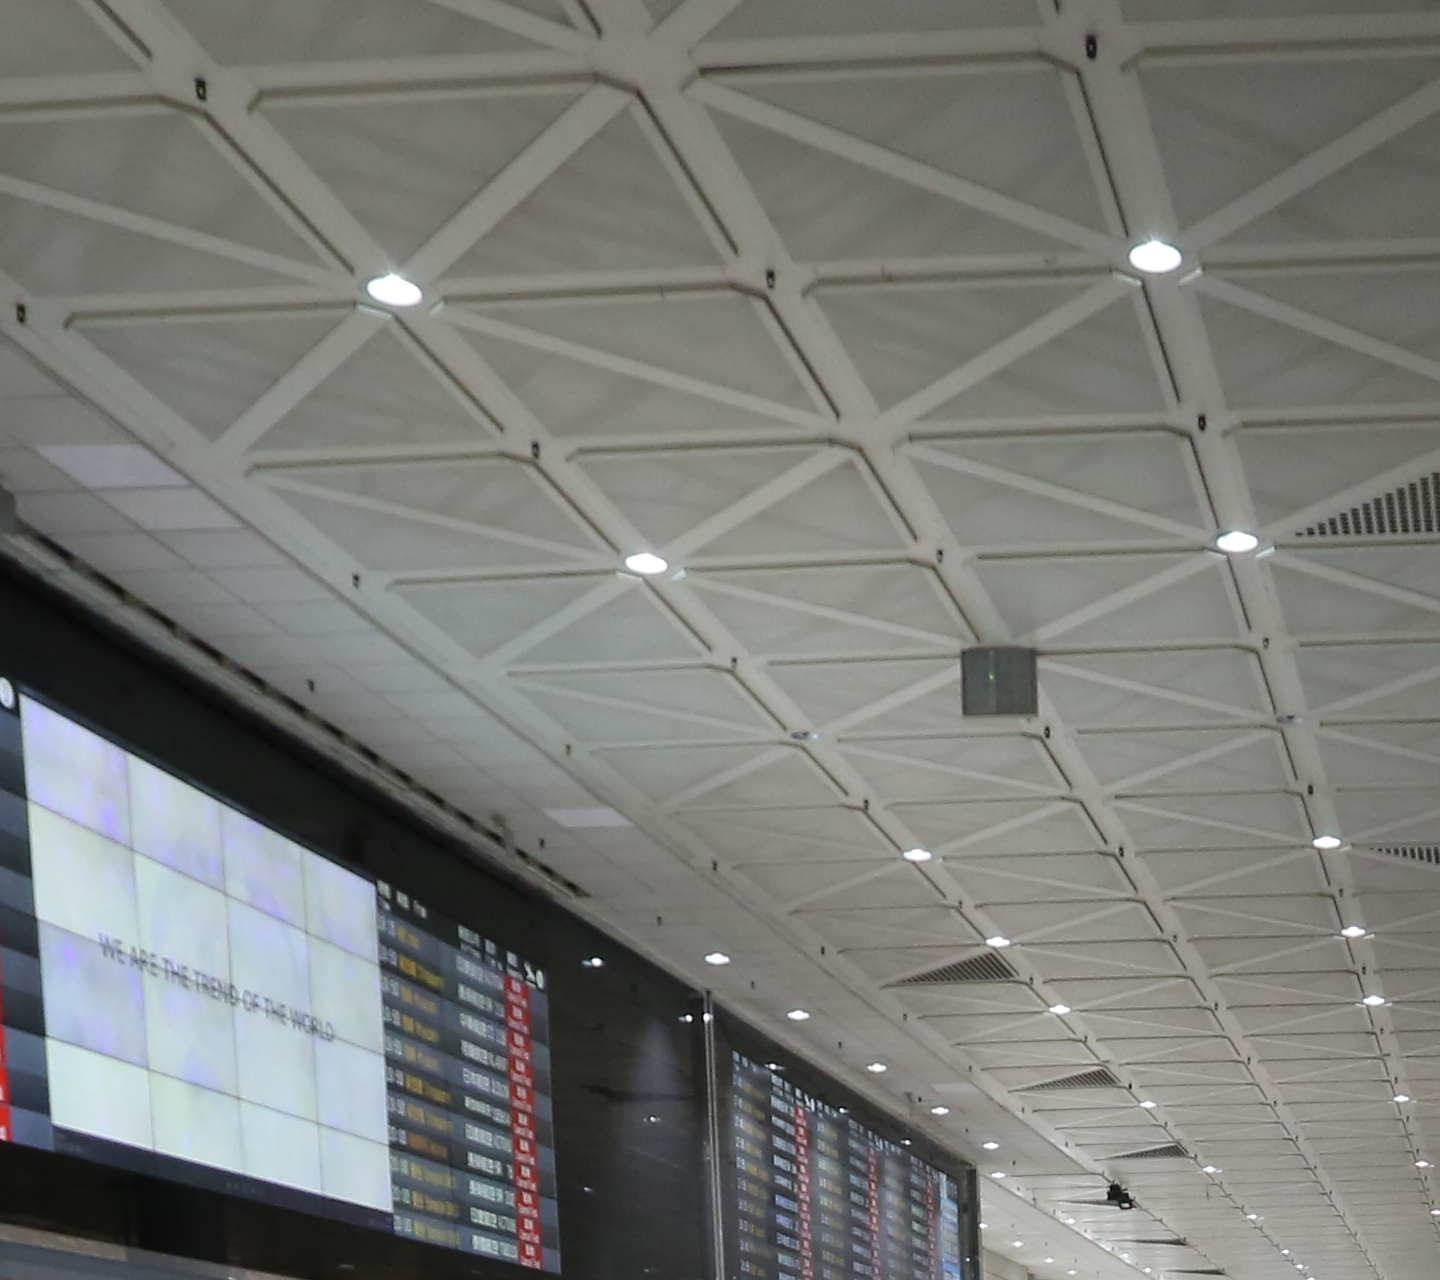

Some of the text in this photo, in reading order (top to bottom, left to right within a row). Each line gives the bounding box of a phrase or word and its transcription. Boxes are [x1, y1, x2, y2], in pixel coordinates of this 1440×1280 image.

[98, 931, 335, 1042] WE ARE THE TREND OF THE WORLD
